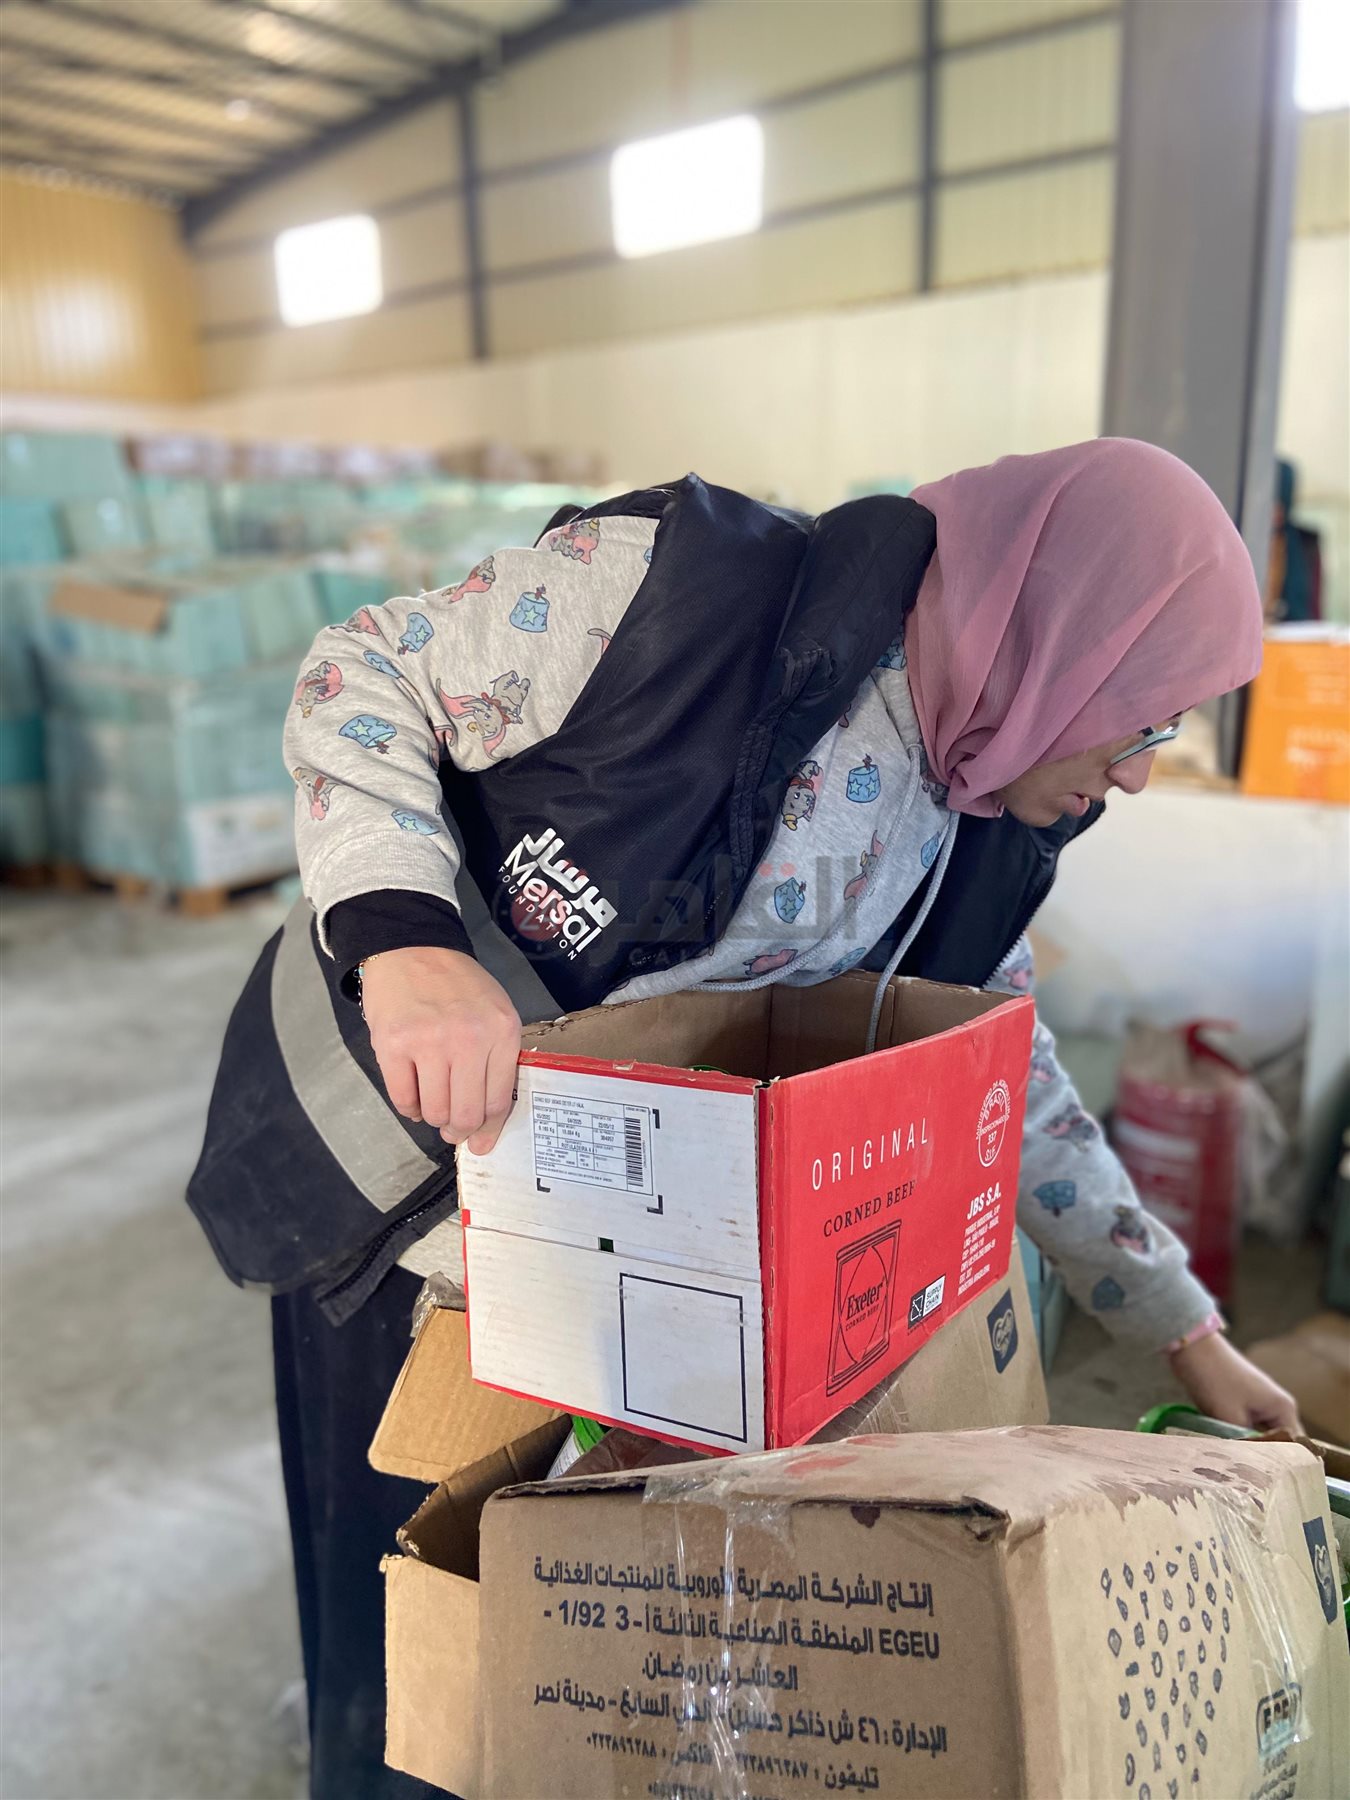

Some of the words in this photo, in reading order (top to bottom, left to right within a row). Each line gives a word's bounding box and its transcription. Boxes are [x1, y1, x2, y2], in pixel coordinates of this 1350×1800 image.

[498, 866, 577, 961] FOUNDATION
[503, 840, 603, 953] Mersal
[812, 1117, 928, 1190] ORIGINAL
[824, 1197, 882, 1237] CORNED
[886, 1180, 916, 1208] BEEF
[967, 1192, 985, 1220] JBS
[846, 1282, 883, 1321] Exeter
[534, 1556, 593, 1587] الغذائية
[595, 1564, 664, 1593] للمنتجات
[737, 1567, 808, 1602] المصرية
[811, 1572, 883, 1609] الشركة
[887, 1581, 934, 1617] إنتاج
[558, 1599, 606, 1629] 1/92
[653, 1607, 706, 1638] الثالثة
[709, 1611, 788, 1646] الصناعية
[791, 1617, 874, 1655] المنطقة
[879, 1628, 940, 1659] EGEU
[735, 1656, 798, 1691] العاشر
[534, 1681, 561, 1705] نصر
[562, 1678, 606, 1712] مدينة
[620, 1686, 670, 1718] السابع
[787, 1709, 825, 1739] ذاكر
[828, 1709, 854, 1745] ش
